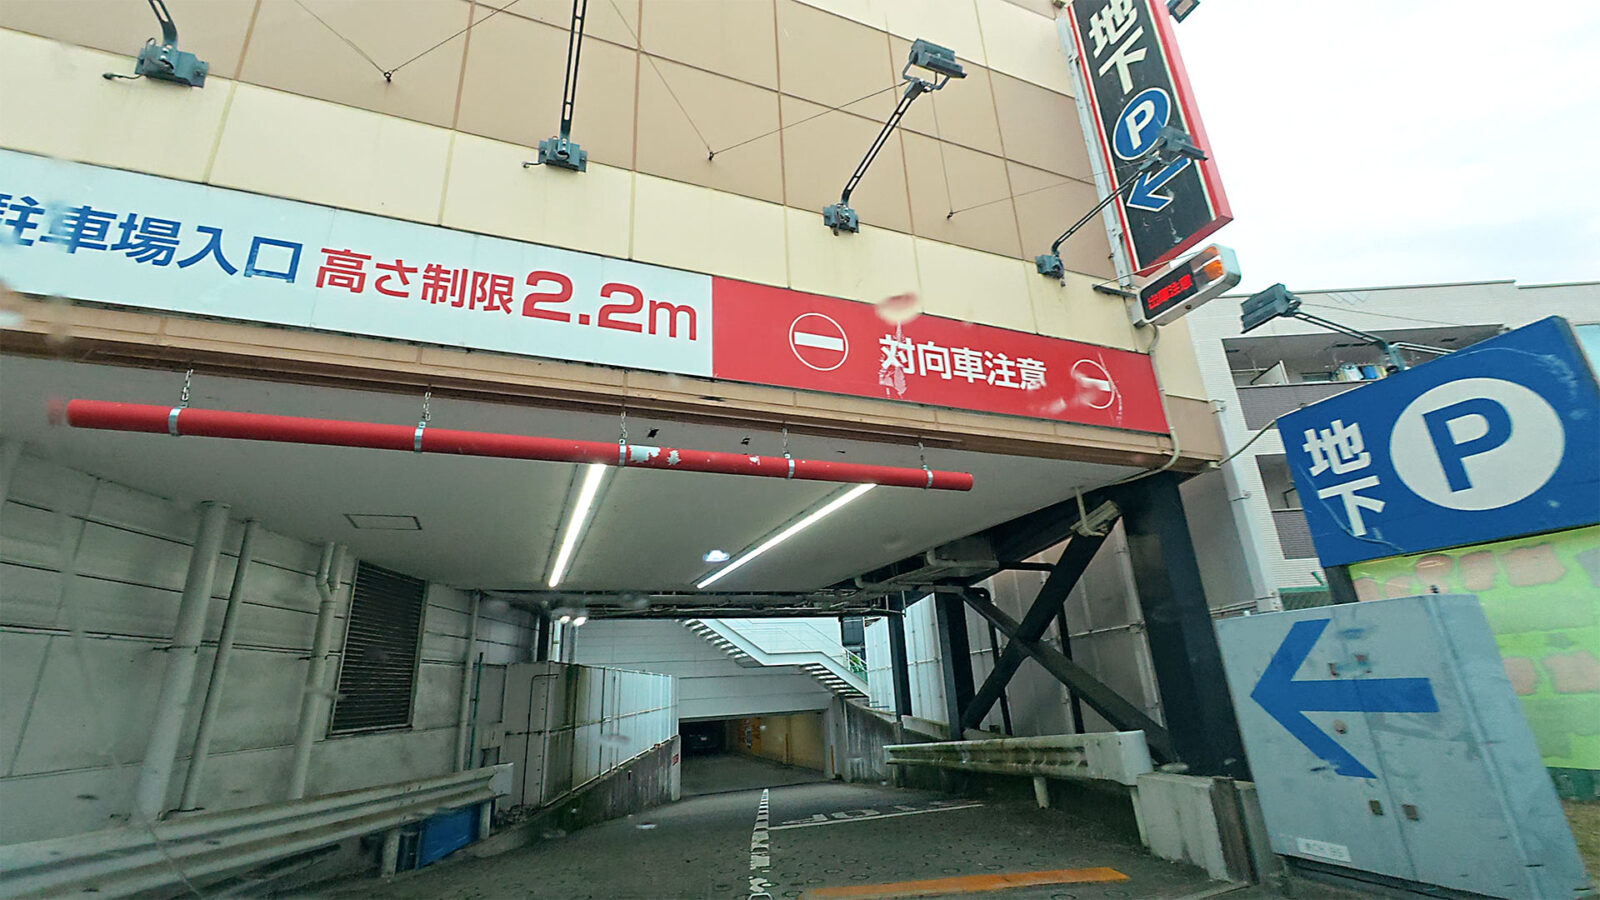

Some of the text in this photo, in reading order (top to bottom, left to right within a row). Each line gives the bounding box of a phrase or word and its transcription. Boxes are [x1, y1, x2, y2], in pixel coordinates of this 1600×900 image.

[1089, 0, 1156, 150] 地下 P
[315, 247, 698, 341] 高さ制限2.2m
[878, 333, 1047, 390] 対向車注意
[1302, 419, 1386, 537] 地下
[1422, 397, 1513, 493] P
